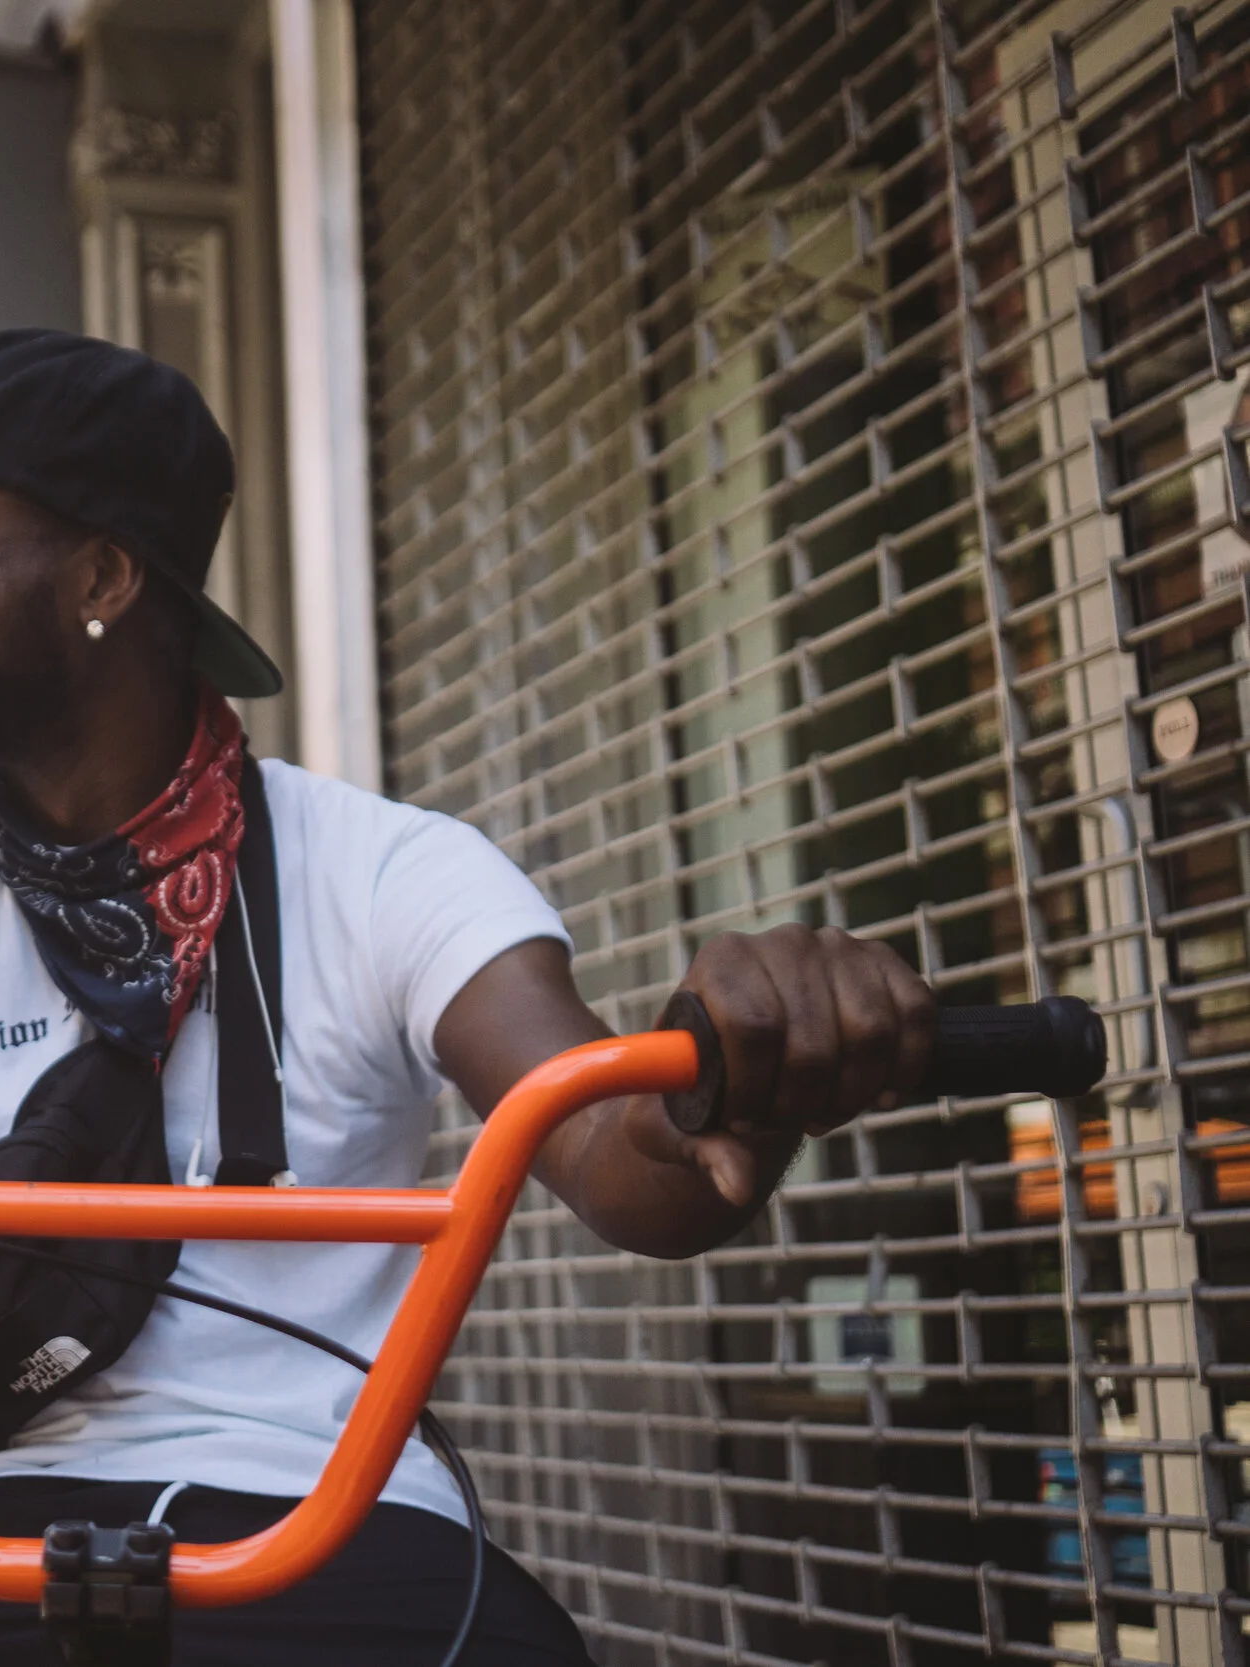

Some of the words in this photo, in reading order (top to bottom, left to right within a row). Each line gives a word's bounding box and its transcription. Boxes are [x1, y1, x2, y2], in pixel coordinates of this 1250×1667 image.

[19, 1347, 51, 1371] THE
[10, 1357, 62, 1392] NORTH
[30, 1364, 70, 1393] FACE
